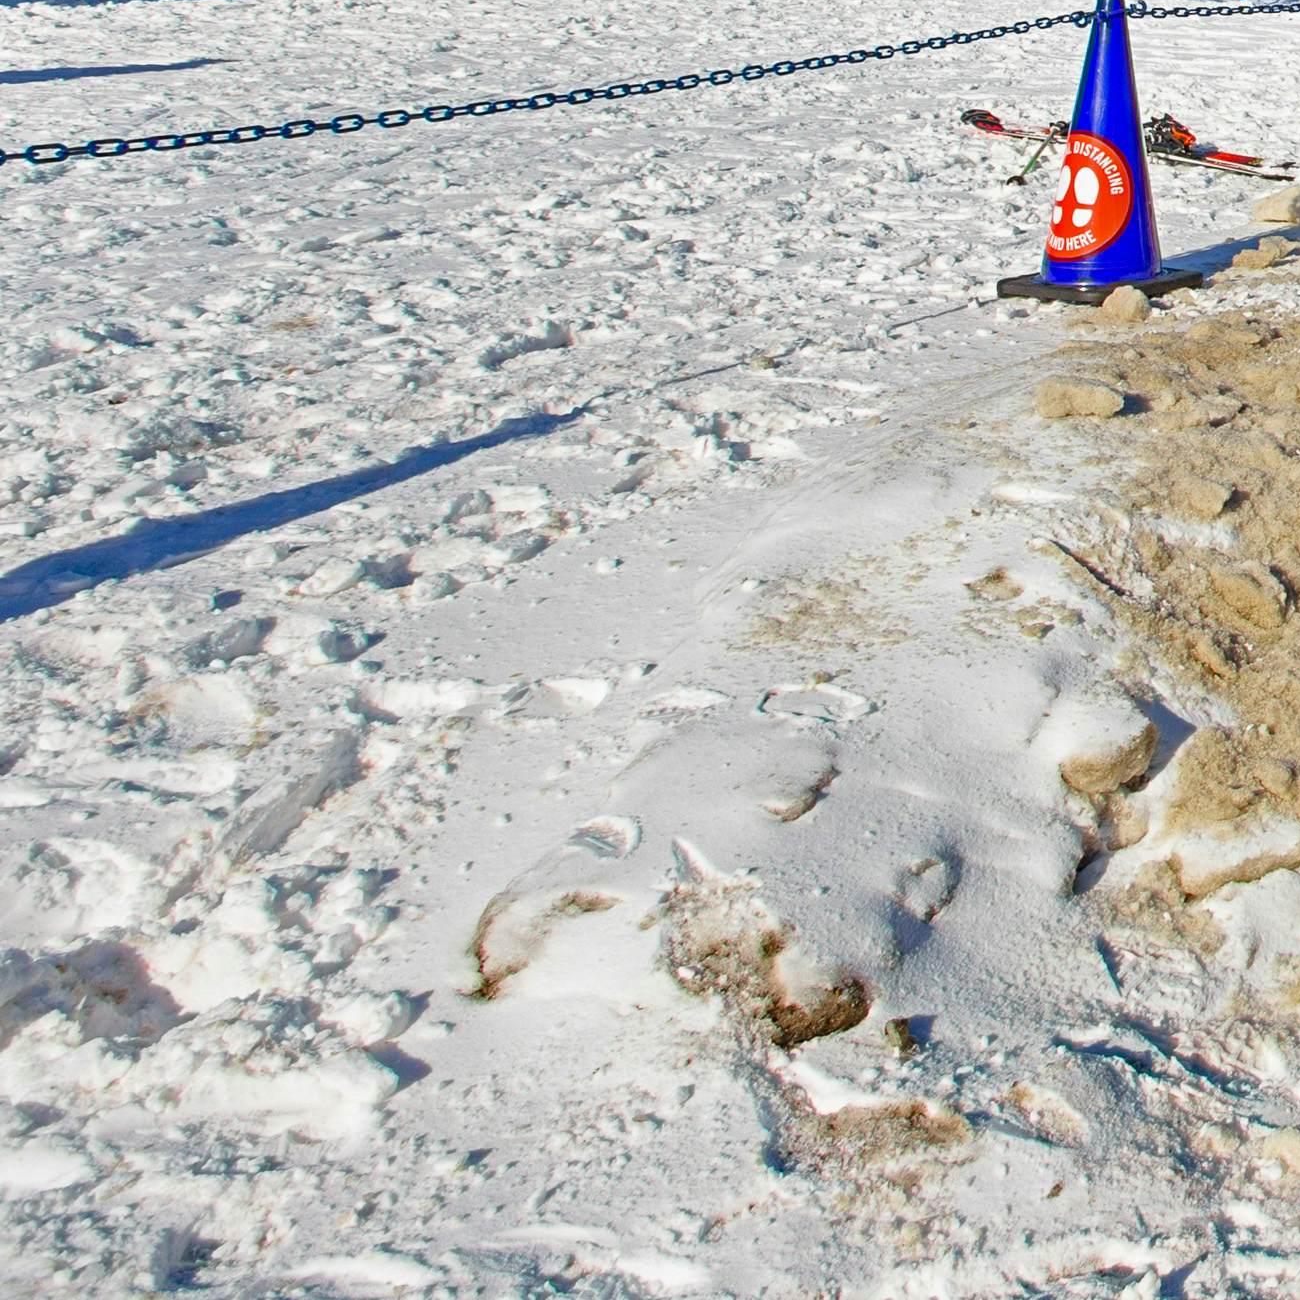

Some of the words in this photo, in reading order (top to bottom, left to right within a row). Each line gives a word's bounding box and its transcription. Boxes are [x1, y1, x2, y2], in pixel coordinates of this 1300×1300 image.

[1073, 140, 1125, 196] DISTANCING
[1046, 236, 1065, 251] AND
[1065, 229, 1097, 251] HERE
